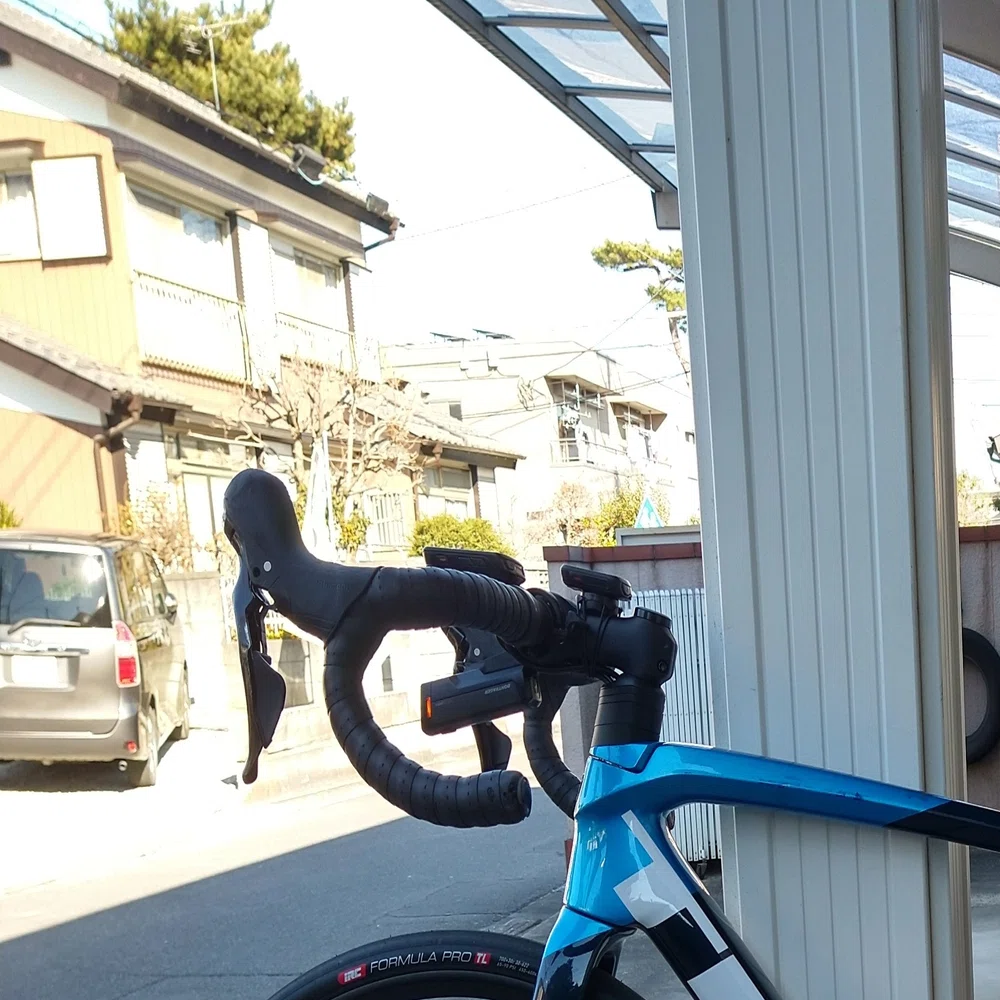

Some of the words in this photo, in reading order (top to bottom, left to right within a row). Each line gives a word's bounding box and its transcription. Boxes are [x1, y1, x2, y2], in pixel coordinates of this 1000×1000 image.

[343, 966, 363, 983] IRC
[370, 953, 437, 974] FORMULA
[442, 950, 473, 963] PRO
[475, 952, 488, 965] TL
